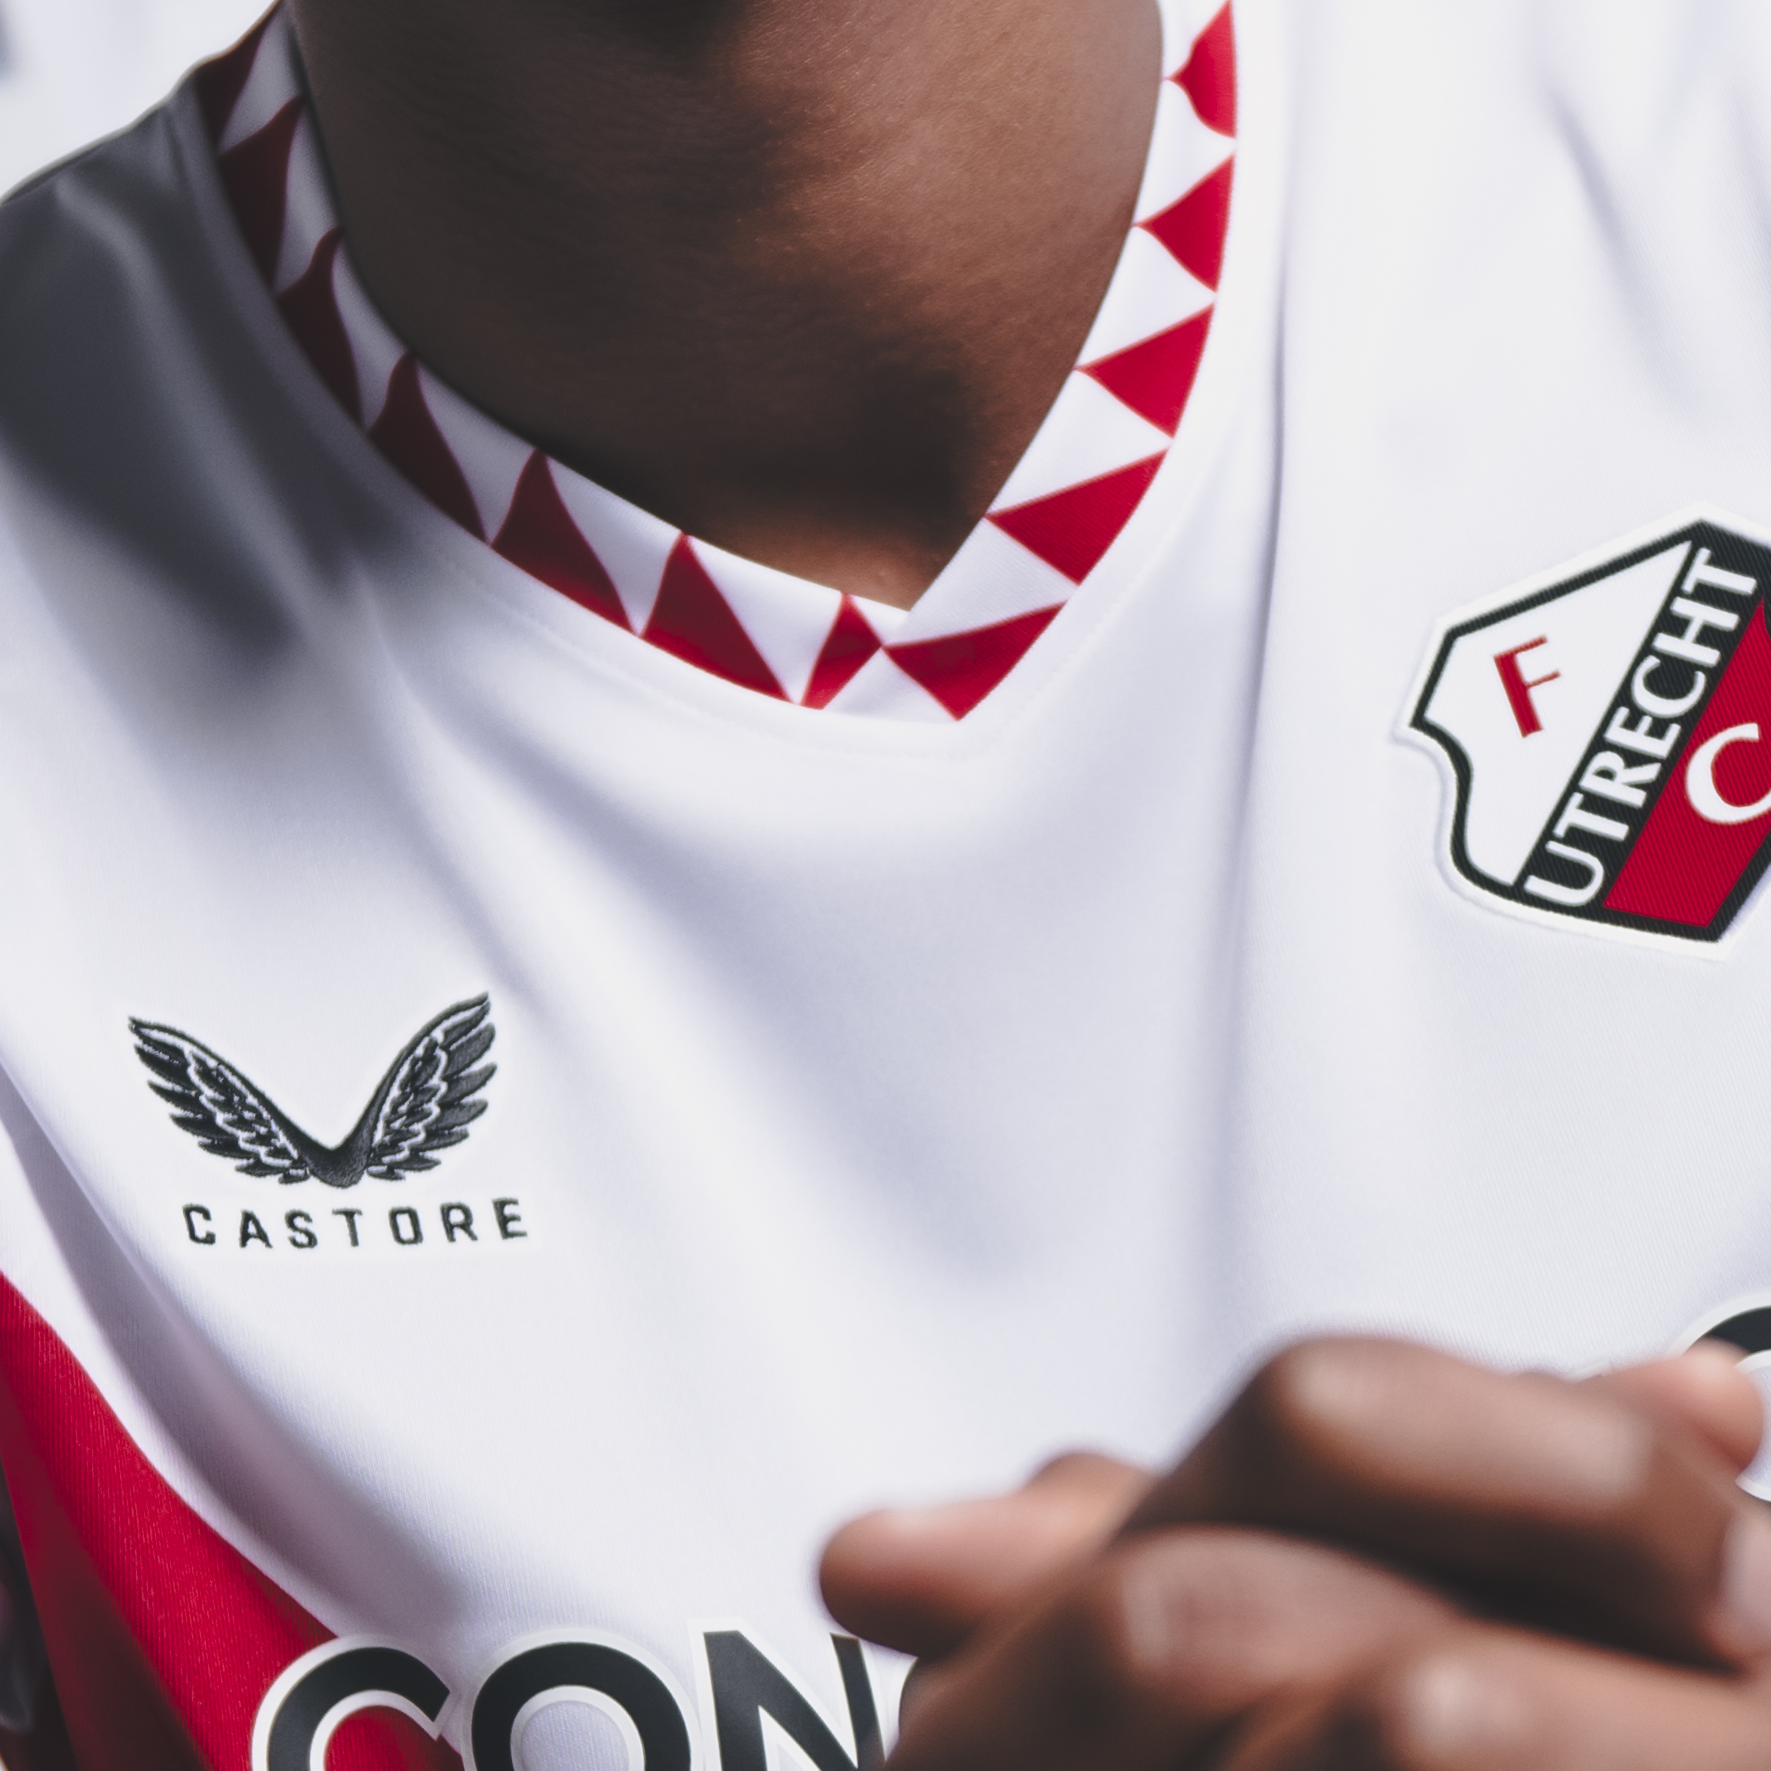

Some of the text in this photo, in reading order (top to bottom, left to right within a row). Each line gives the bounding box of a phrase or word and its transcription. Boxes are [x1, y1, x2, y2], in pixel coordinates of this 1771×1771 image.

[1494, 635, 1560, 738] F
[1523, 547, 1757, 907] UTRECHT
[182, 1198, 527, 1249] CASTORE
